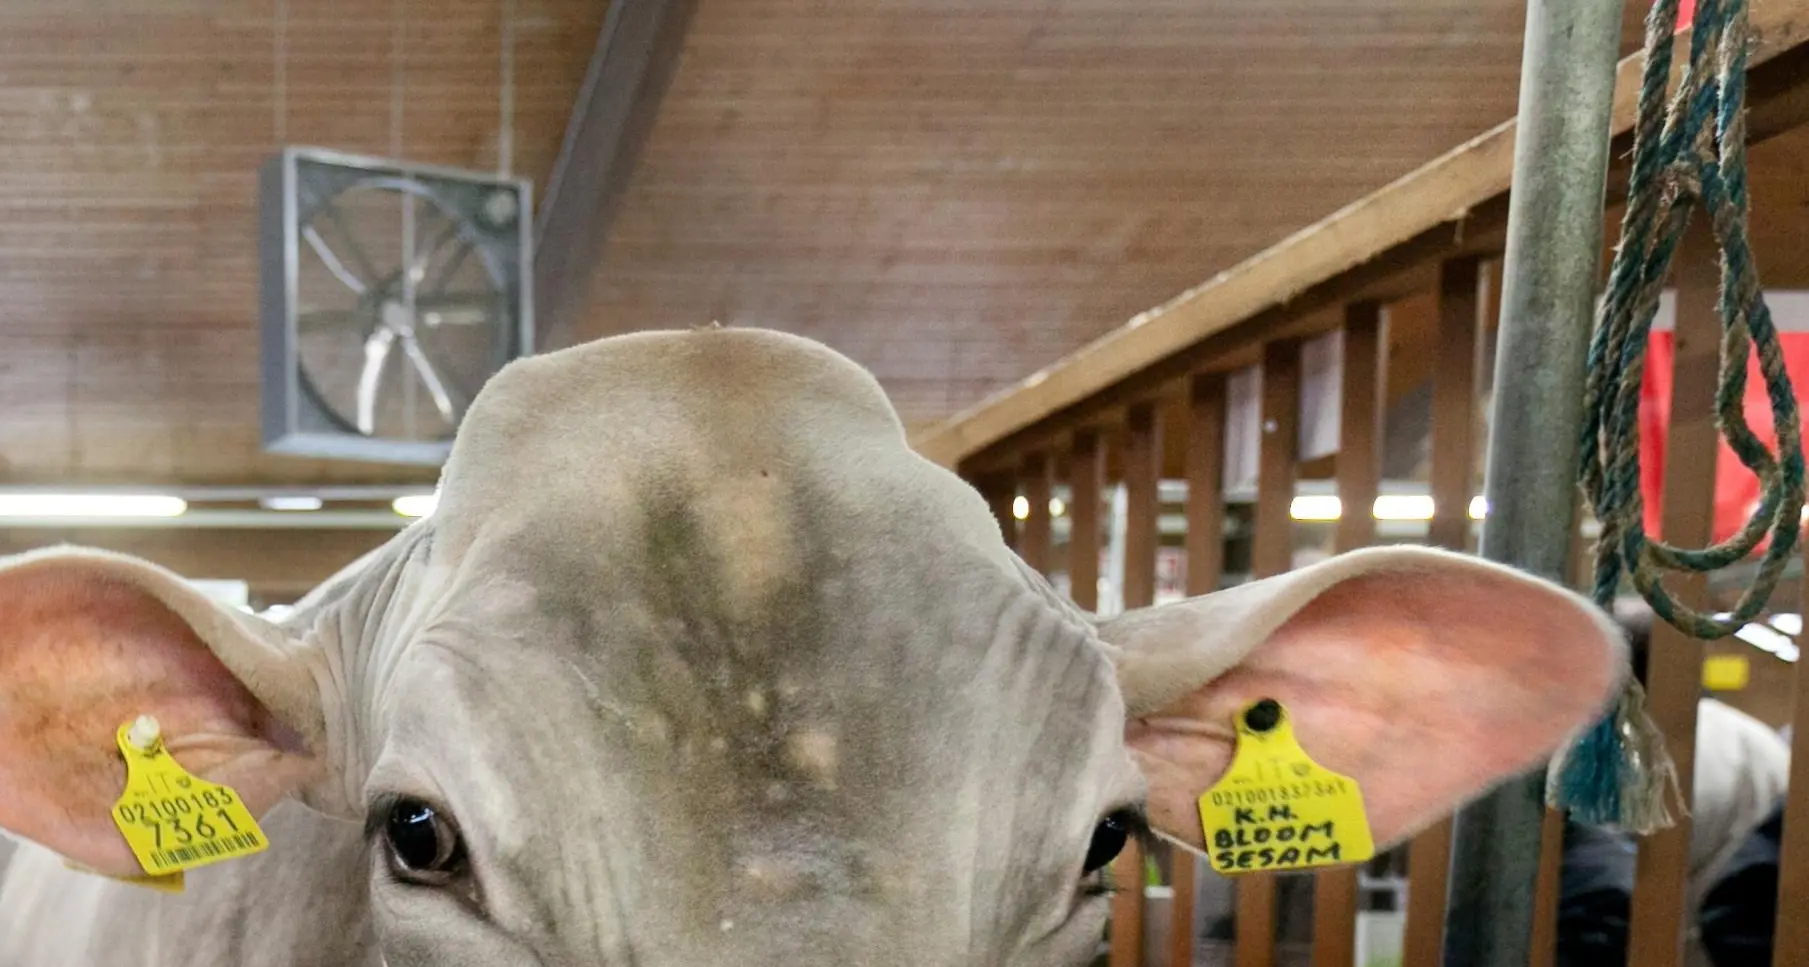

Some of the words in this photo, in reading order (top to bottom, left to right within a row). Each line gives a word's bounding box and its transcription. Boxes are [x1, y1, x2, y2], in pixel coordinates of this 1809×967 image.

[146, 773, 171, 794] IT
[118, 787, 233, 824] 02100183
[143, 808, 239, 849] 7361
[1214, 820, 1334, 849] BLOOM
[1216, 842, 1341, 869] SESAM
